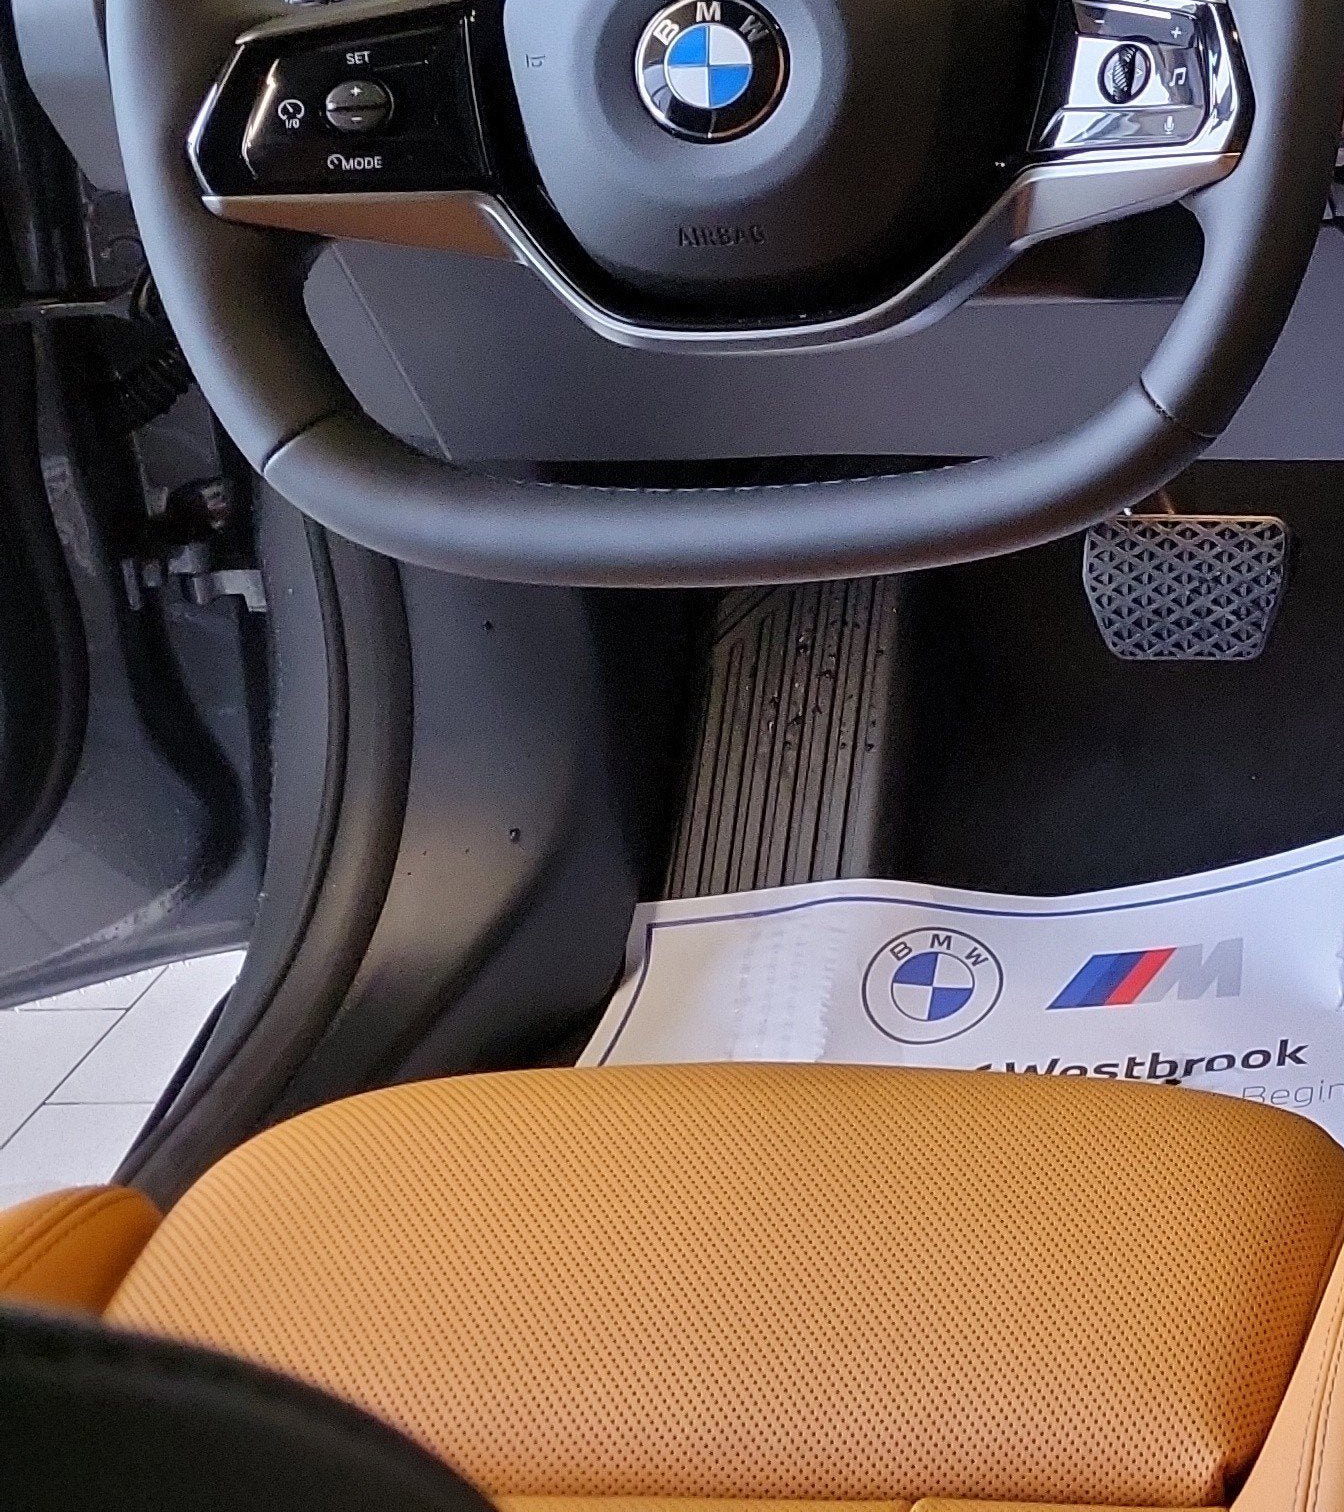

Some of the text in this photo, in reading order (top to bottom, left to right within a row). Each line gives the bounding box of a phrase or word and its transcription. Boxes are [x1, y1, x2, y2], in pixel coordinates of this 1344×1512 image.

[652, 0, 770, 46] BMW
[345, 50, 372, 65] SET
[342, 155, 384, 171] MODE
[679, 226, 766, 247] AIRBAG
[889, 932, 989, 968] BMW
